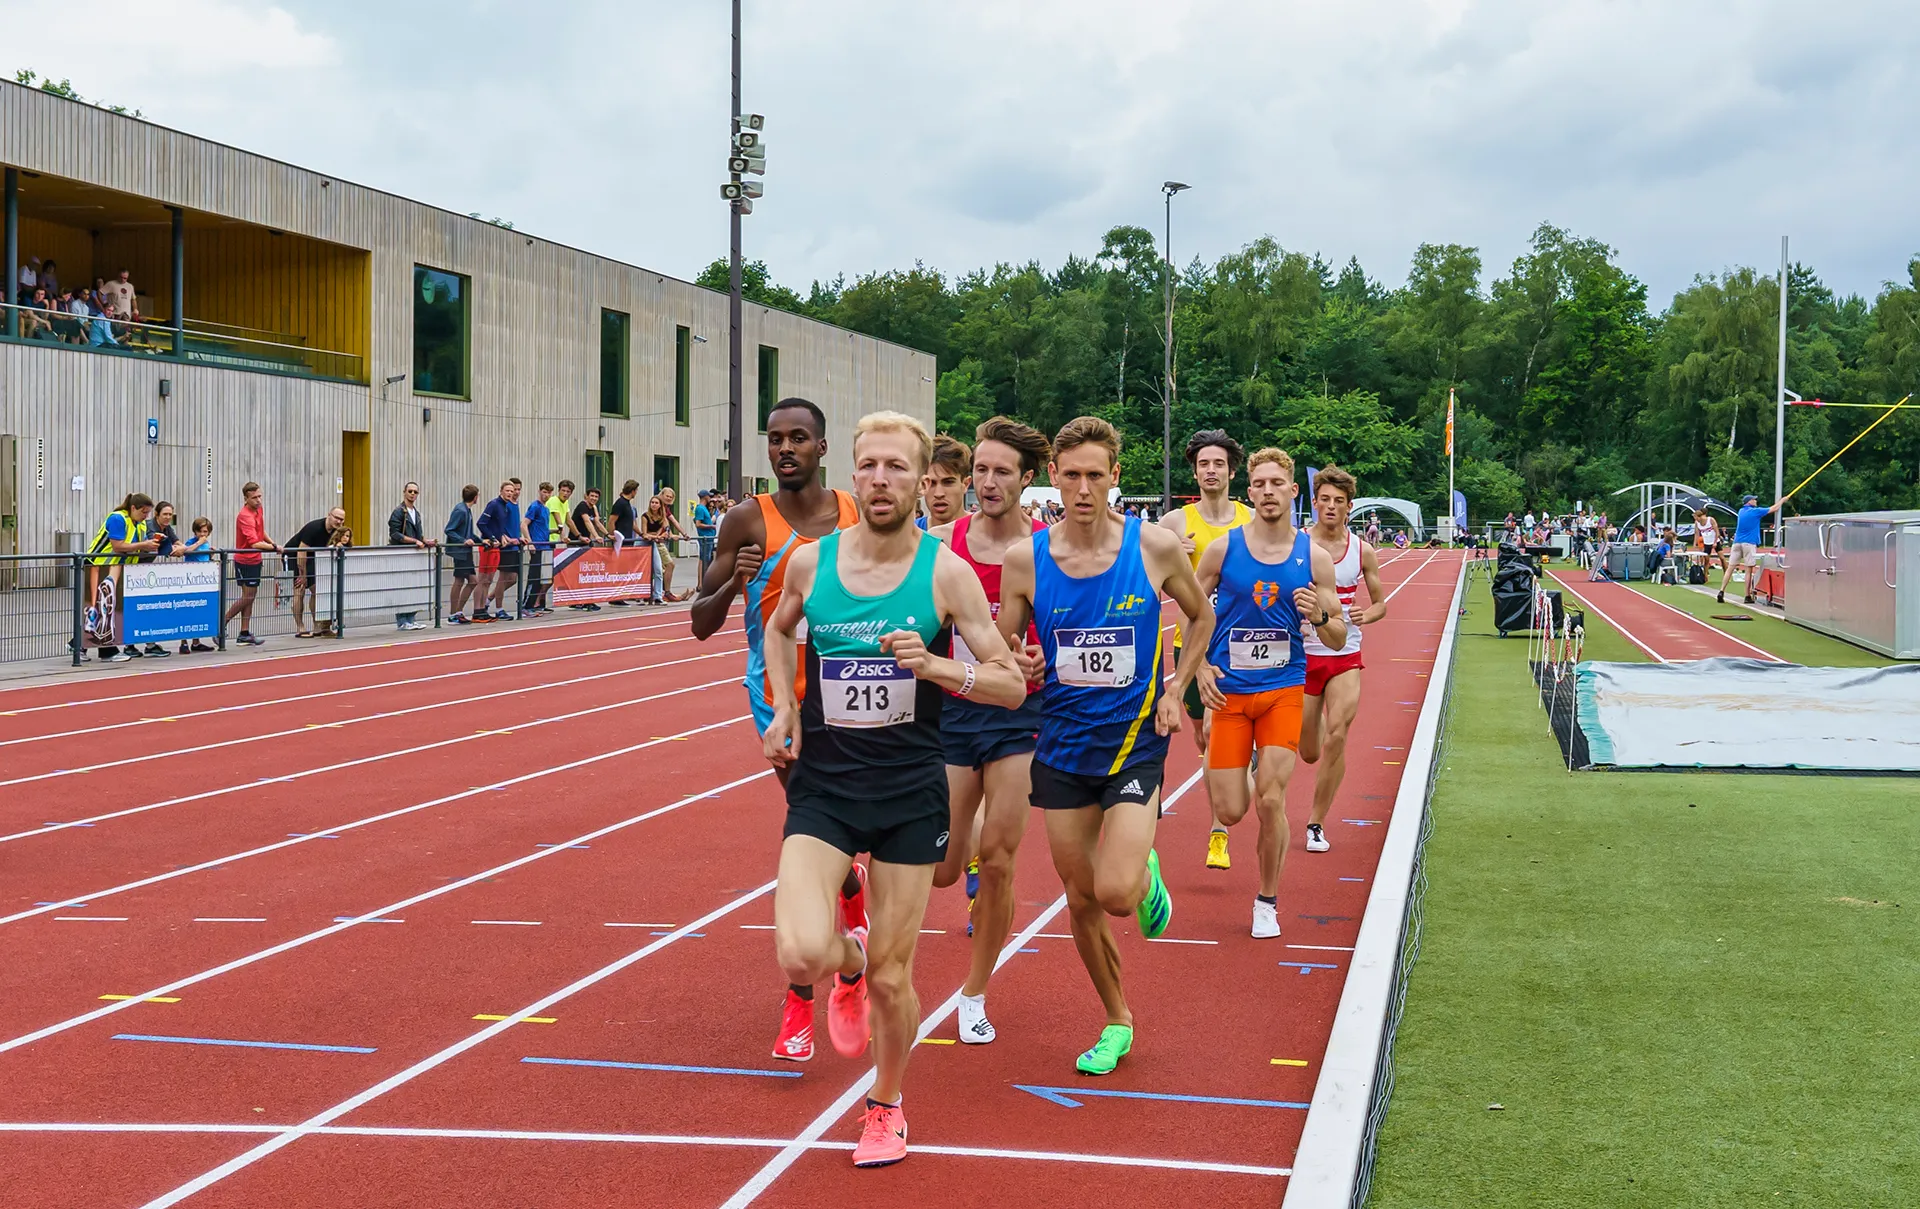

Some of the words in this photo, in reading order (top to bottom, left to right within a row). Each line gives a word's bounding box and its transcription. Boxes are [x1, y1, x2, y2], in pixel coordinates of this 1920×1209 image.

[813, 619, 888, 634] ROTTERDAM
[1251, 644, 1269, 660] 42
[1078, 651, 1114, 673] 182
[845, 685, 890, 711] 213
[1120, 788, 1144, 796] adidas
